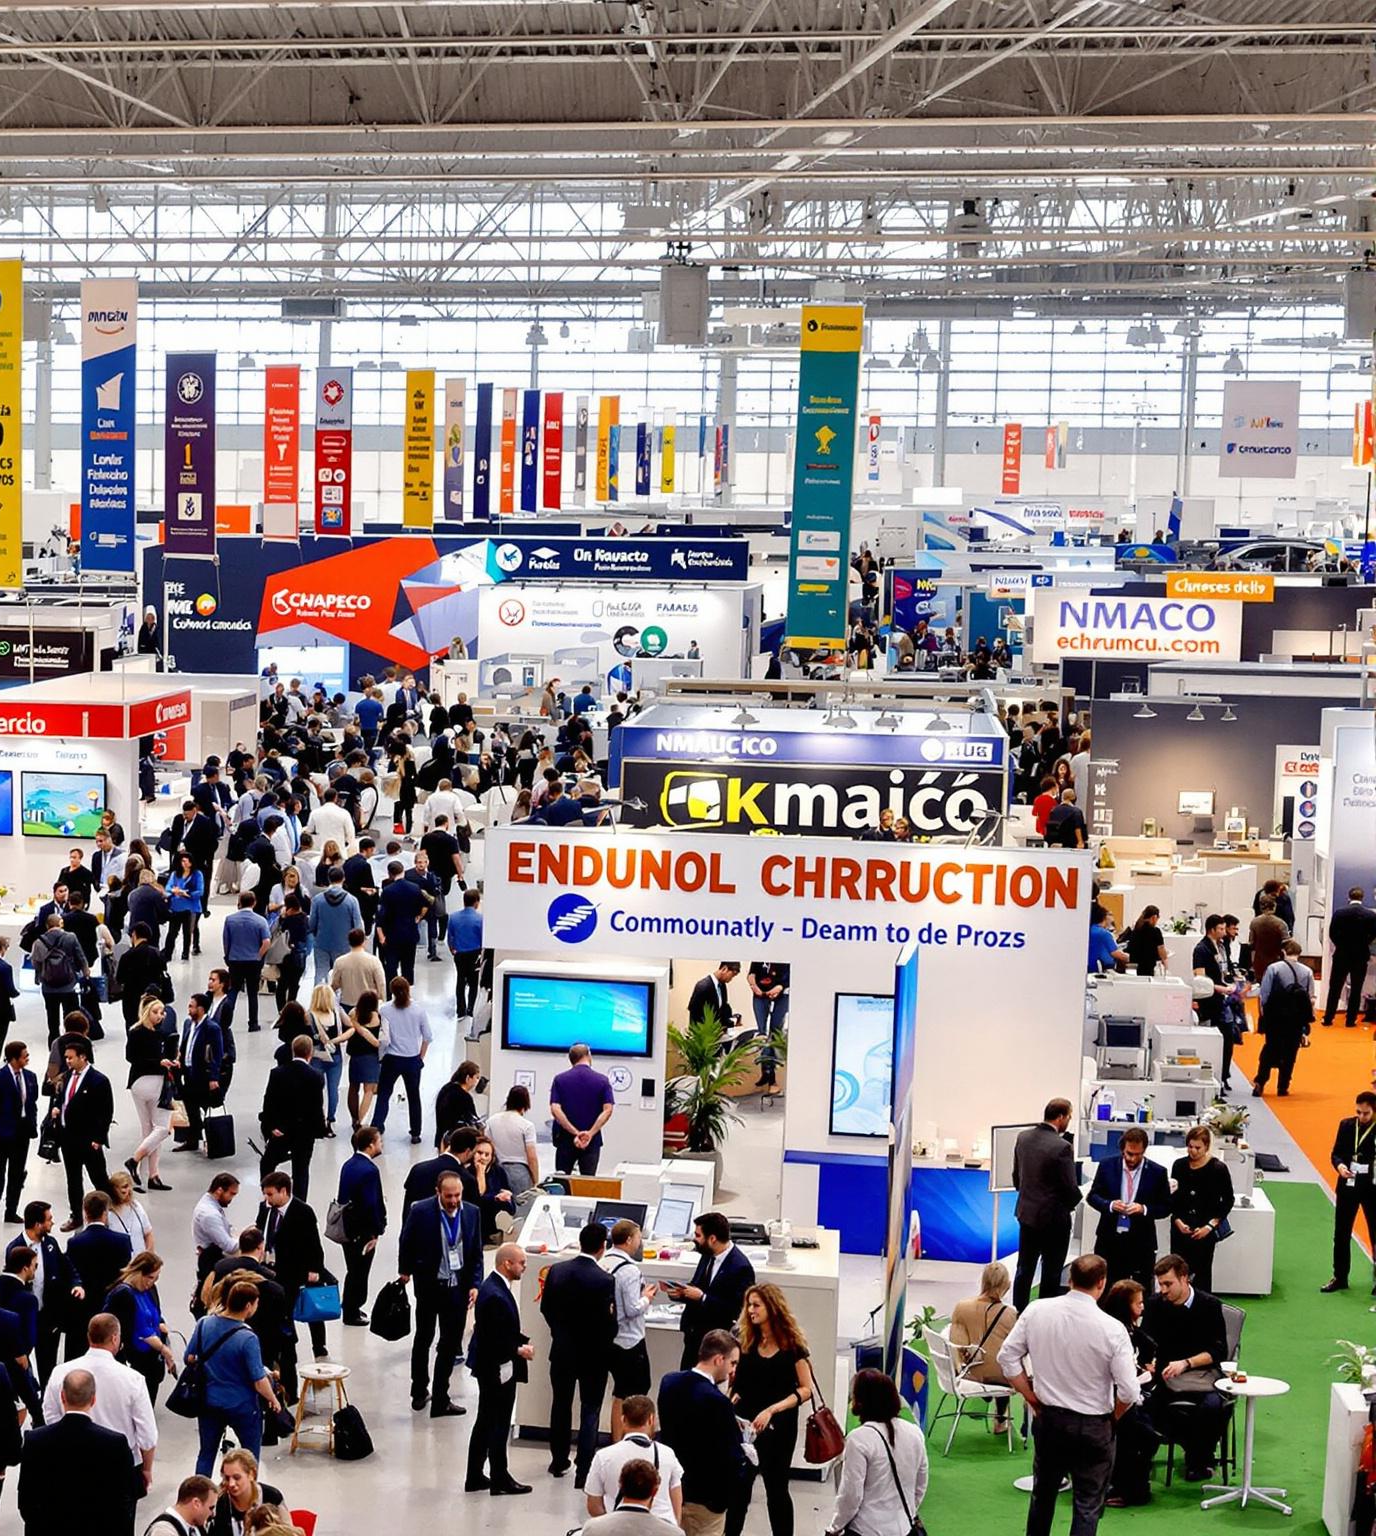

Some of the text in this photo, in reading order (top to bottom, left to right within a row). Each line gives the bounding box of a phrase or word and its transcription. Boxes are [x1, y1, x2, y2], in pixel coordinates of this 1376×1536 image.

[289, 592, 372, 610] CHAPECO
[1059, 600, 1216, 632] NMACO
[508, 841, 1080, 911] ENDUNOL CHRRUCTION
[610, 909, 774, 943] Commounatly
[884, 921, 911, 944] to
[917, 920, 949, 947] de
[956, 923, 1027, 950] Prozs
